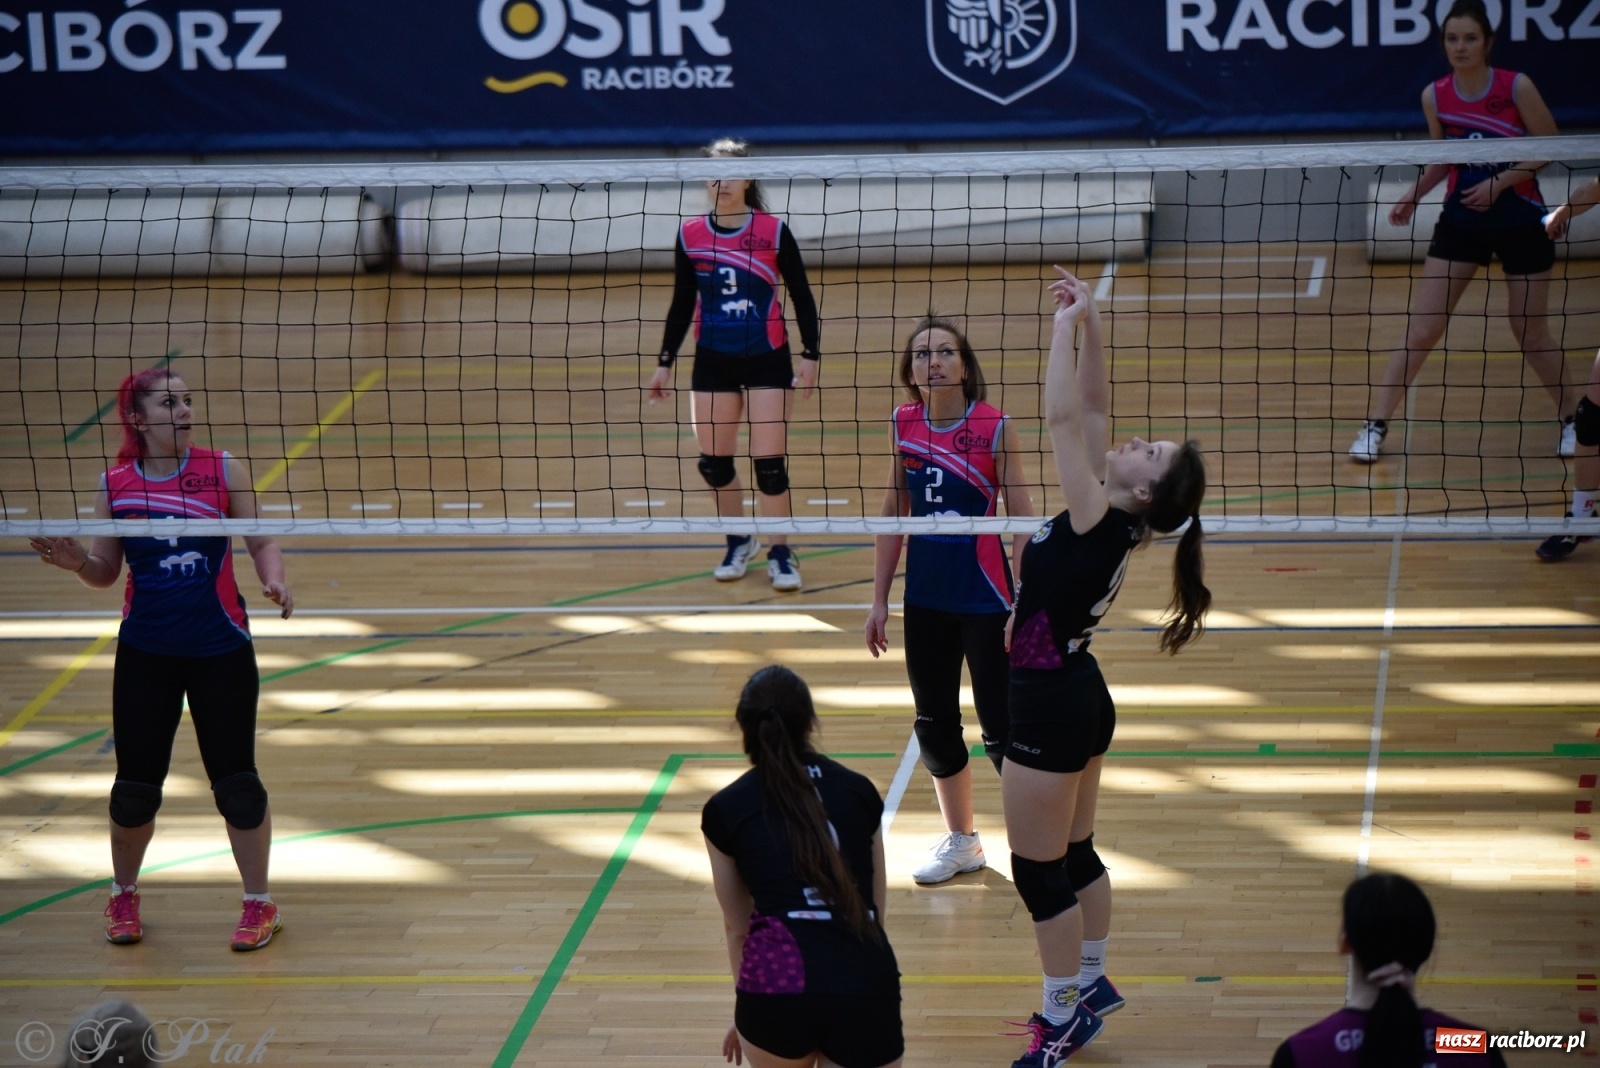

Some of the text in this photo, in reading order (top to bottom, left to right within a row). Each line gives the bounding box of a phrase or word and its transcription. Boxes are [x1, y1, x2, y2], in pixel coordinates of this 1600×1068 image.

[581, 64, 734, 91] RACIBÓRZ
[718, 267, 738, 295] 3
[925, 467, 944, 503] 2
